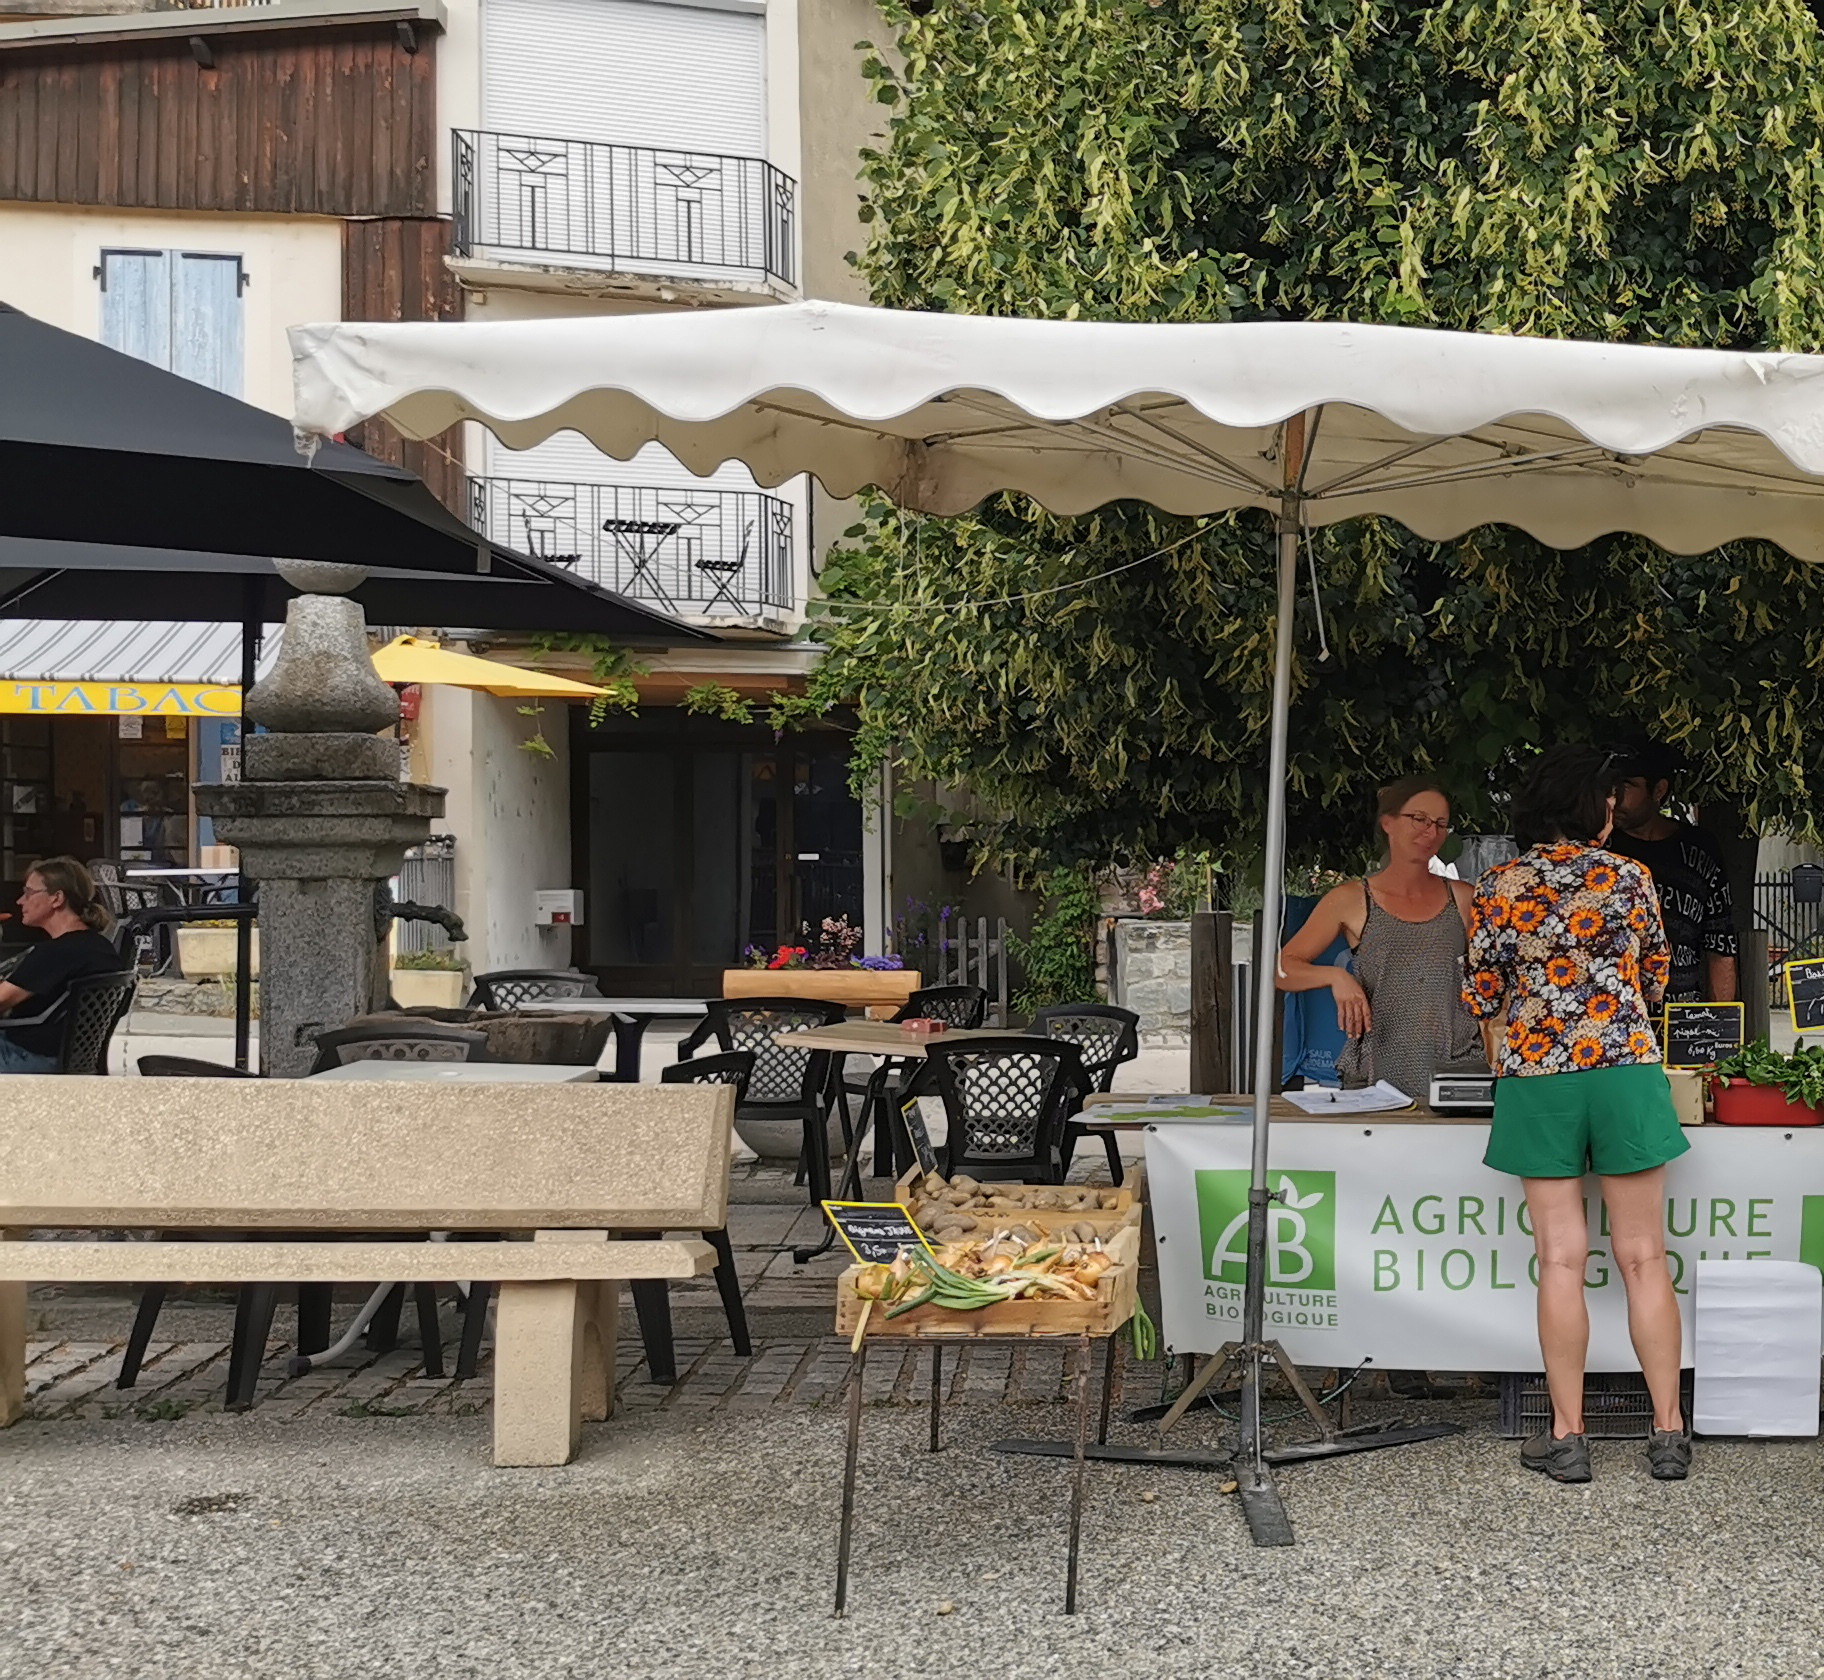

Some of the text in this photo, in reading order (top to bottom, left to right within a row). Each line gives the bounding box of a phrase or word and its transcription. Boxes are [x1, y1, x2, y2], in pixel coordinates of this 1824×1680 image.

[1370, 1193, 1774, 1237] AGRILURE
[1211, 1208, 1314, 1284] AB
[1373, 1248, 1773, 1295] BIOLGQ
[1204, 1284, 1338, 1308] AGRULTURE
[1206, 1302, 1339, 1327] BIOGIQUE
